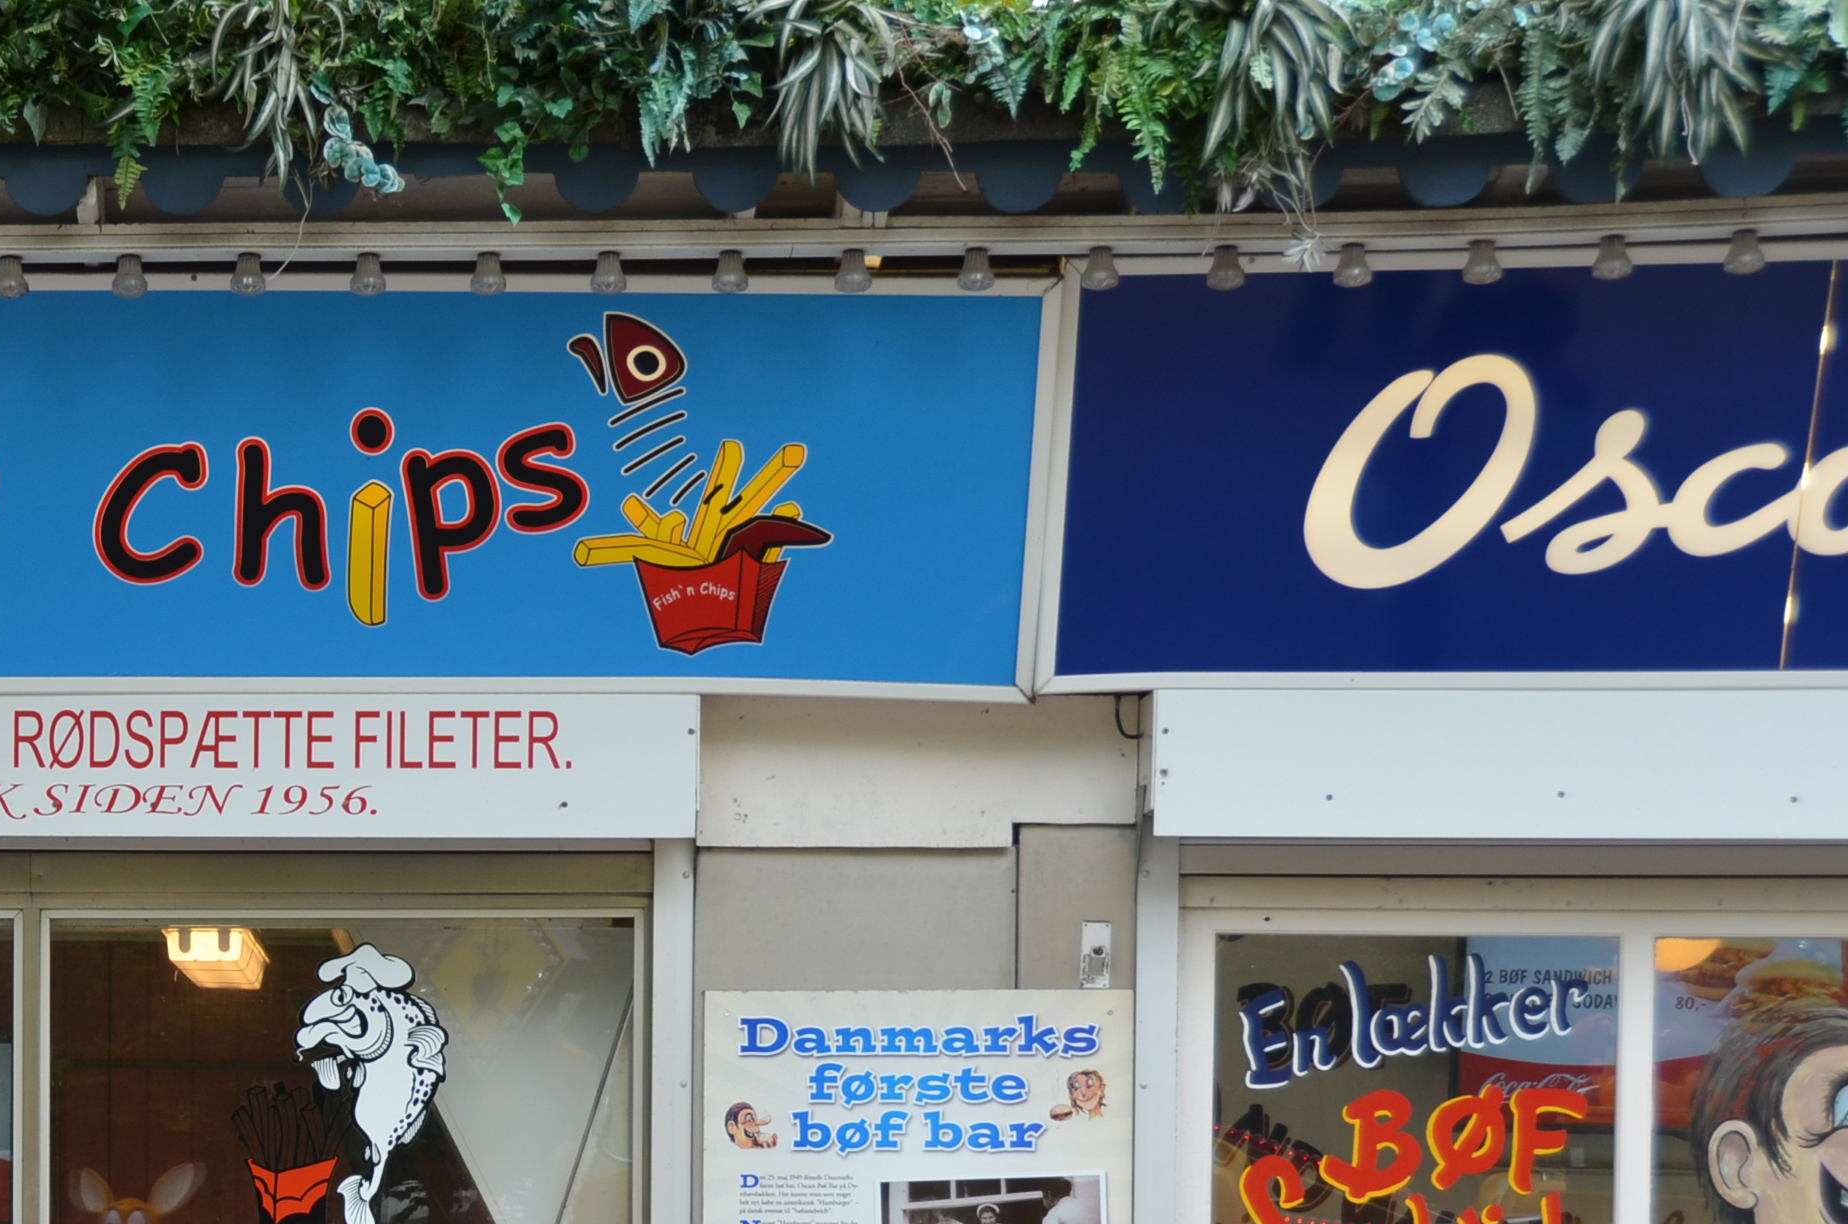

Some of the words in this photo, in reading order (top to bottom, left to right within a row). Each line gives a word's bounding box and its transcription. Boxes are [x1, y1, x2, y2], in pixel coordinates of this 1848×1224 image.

[93, 407, 589, 627] Chips
[700, 582, 736, 601] Chips
[14, 709, 335, 770] RØDSPÆTTE
[353, 710, 573, 771] FILETER.
[33, 783, 243, 818] SIDEN
[255, 784, 379, 818] 1956.
[1499, 969, 1527, 984] BØF
[1533, 969, 1612, 985] SANDWICH
[1238, 988, 1337, 1089] En
[1339, 953, 1589, 1068] lækker
[1675, 997, 1707, 1011] 80,-
[738, 1014, 1100, 1057] Danmarks
[808, 1062, 1028, 1105] første
[792, 1110, 909, 1155] bøf
[923, 1110, 1045, 1152] bar
[1320, 1087, 1589, 1202] BØF
